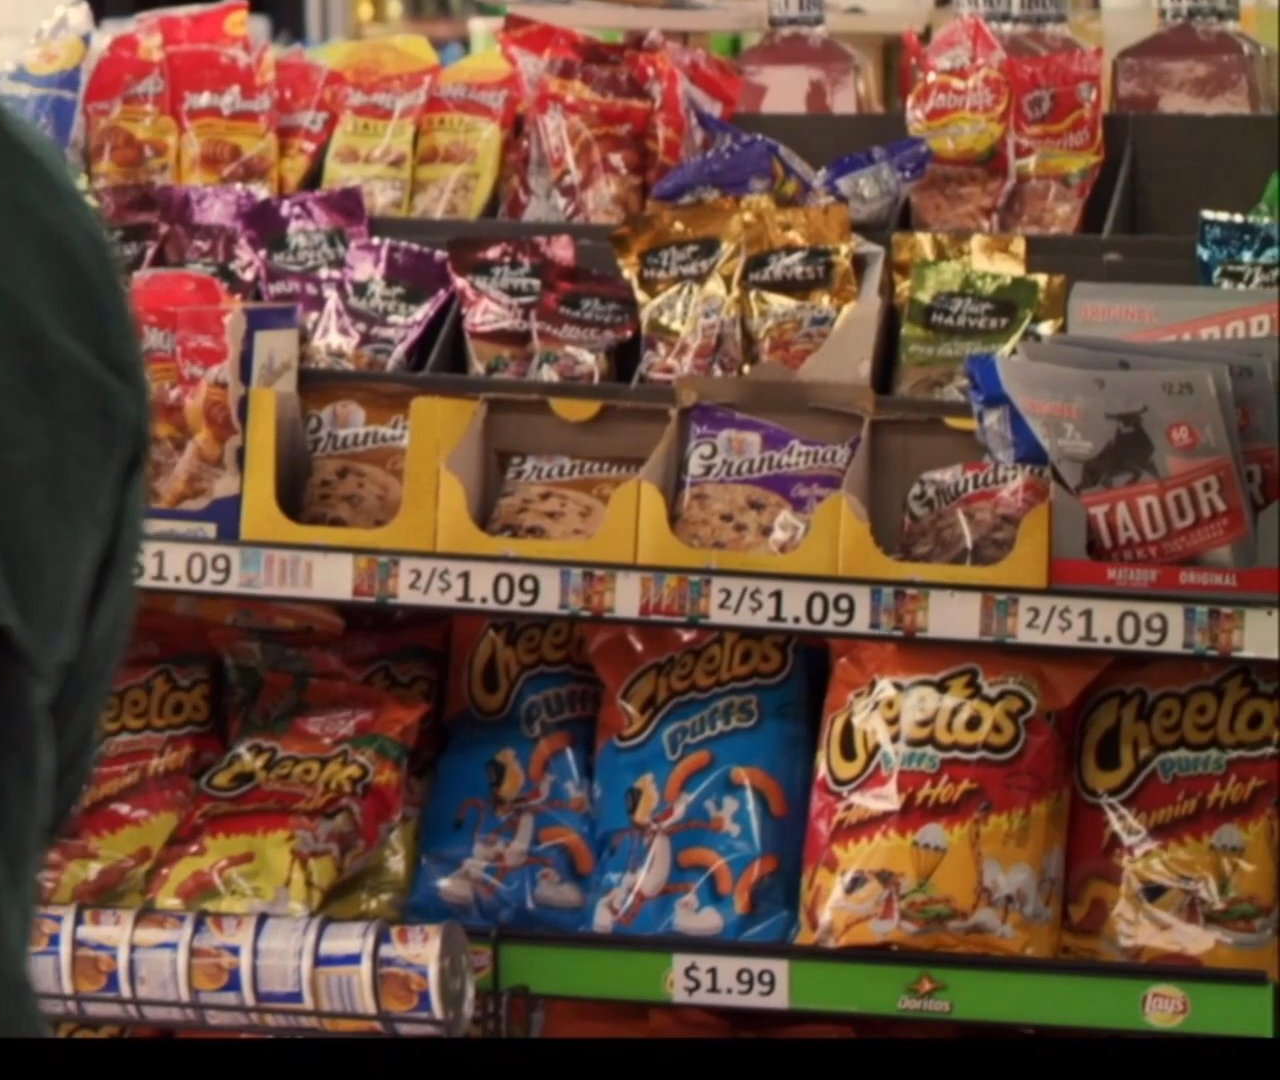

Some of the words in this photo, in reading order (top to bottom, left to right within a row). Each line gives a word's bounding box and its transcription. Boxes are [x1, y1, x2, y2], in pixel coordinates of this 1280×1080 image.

[747, 264, 826, 283] HARVEST
[930, 312, 1010, 330] HARVEST
[407, 567, 541, 607] 2/$1.09
[1106, 567, 1160, 583] MATADOR
[1178, 570, 1238, 588] ORIGINAL
[716, 584, 857, 628] 2/$1.09
[1024, 603, 1170, 648] 2/$1.09
[828, 667, 1030, 786] Cheetos
[1080, 670, 1278, 798] Cheeto
[916, 774, 980, 807] Hot
[1208, 774, 1267, 809] Hot
[682, 961, 777, 998] $1.99
[897, 994, 952, 1013] Doritos
